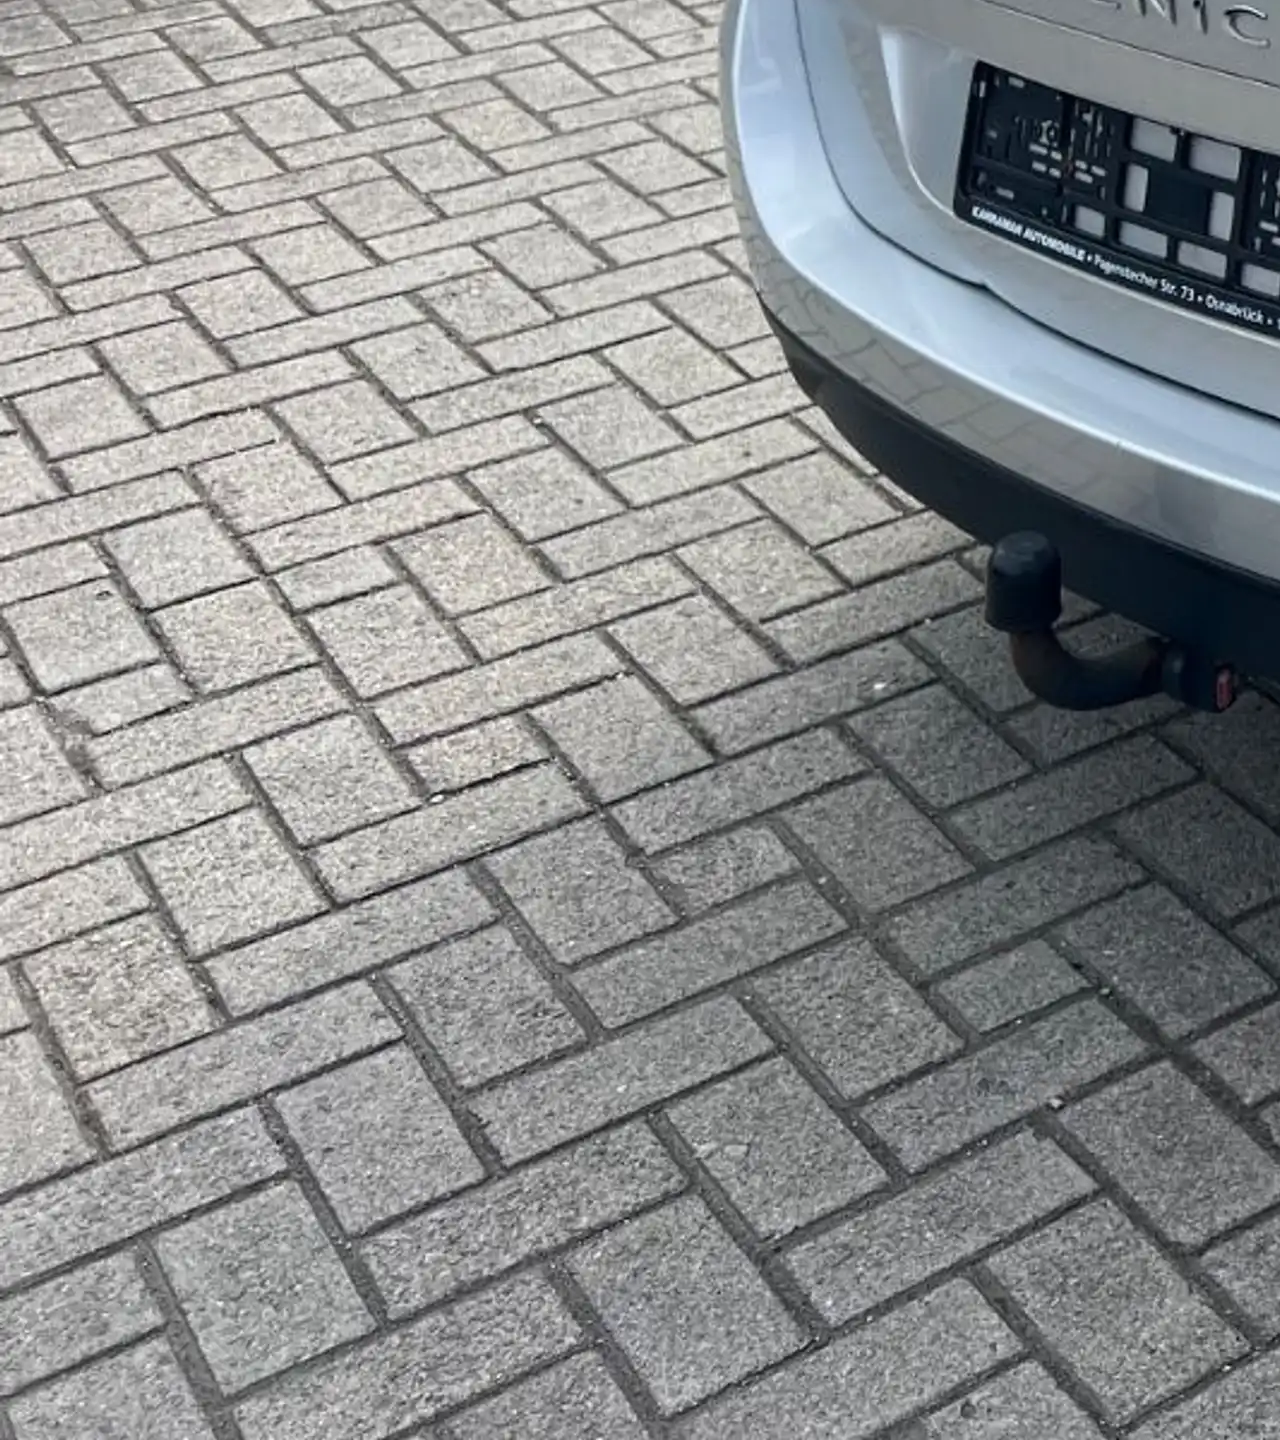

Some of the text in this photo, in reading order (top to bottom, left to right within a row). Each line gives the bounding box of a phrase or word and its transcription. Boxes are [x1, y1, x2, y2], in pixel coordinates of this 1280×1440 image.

[1022, 228, 1085, 262] AUTOMOBILE
[1180, 285, 1195, 302] 73
[1205, 294, 1264, 325] Osnabrück
